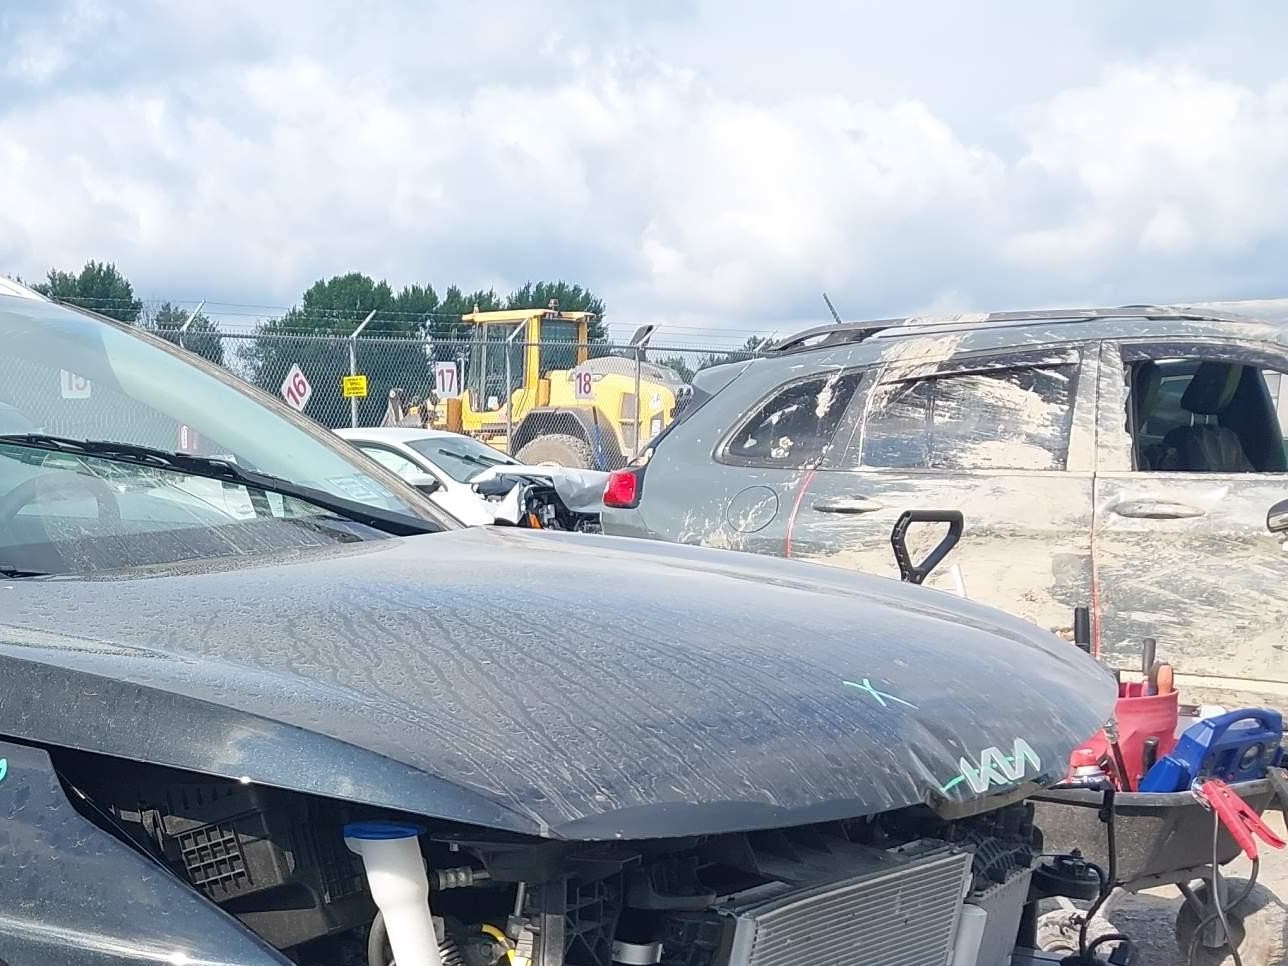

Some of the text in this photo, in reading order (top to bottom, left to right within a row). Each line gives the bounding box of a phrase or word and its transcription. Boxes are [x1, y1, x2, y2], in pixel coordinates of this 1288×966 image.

[287, 373, 307, 406] 16
[438, 369, 454, 393] 17
[576, 372, 592, 394] 18
